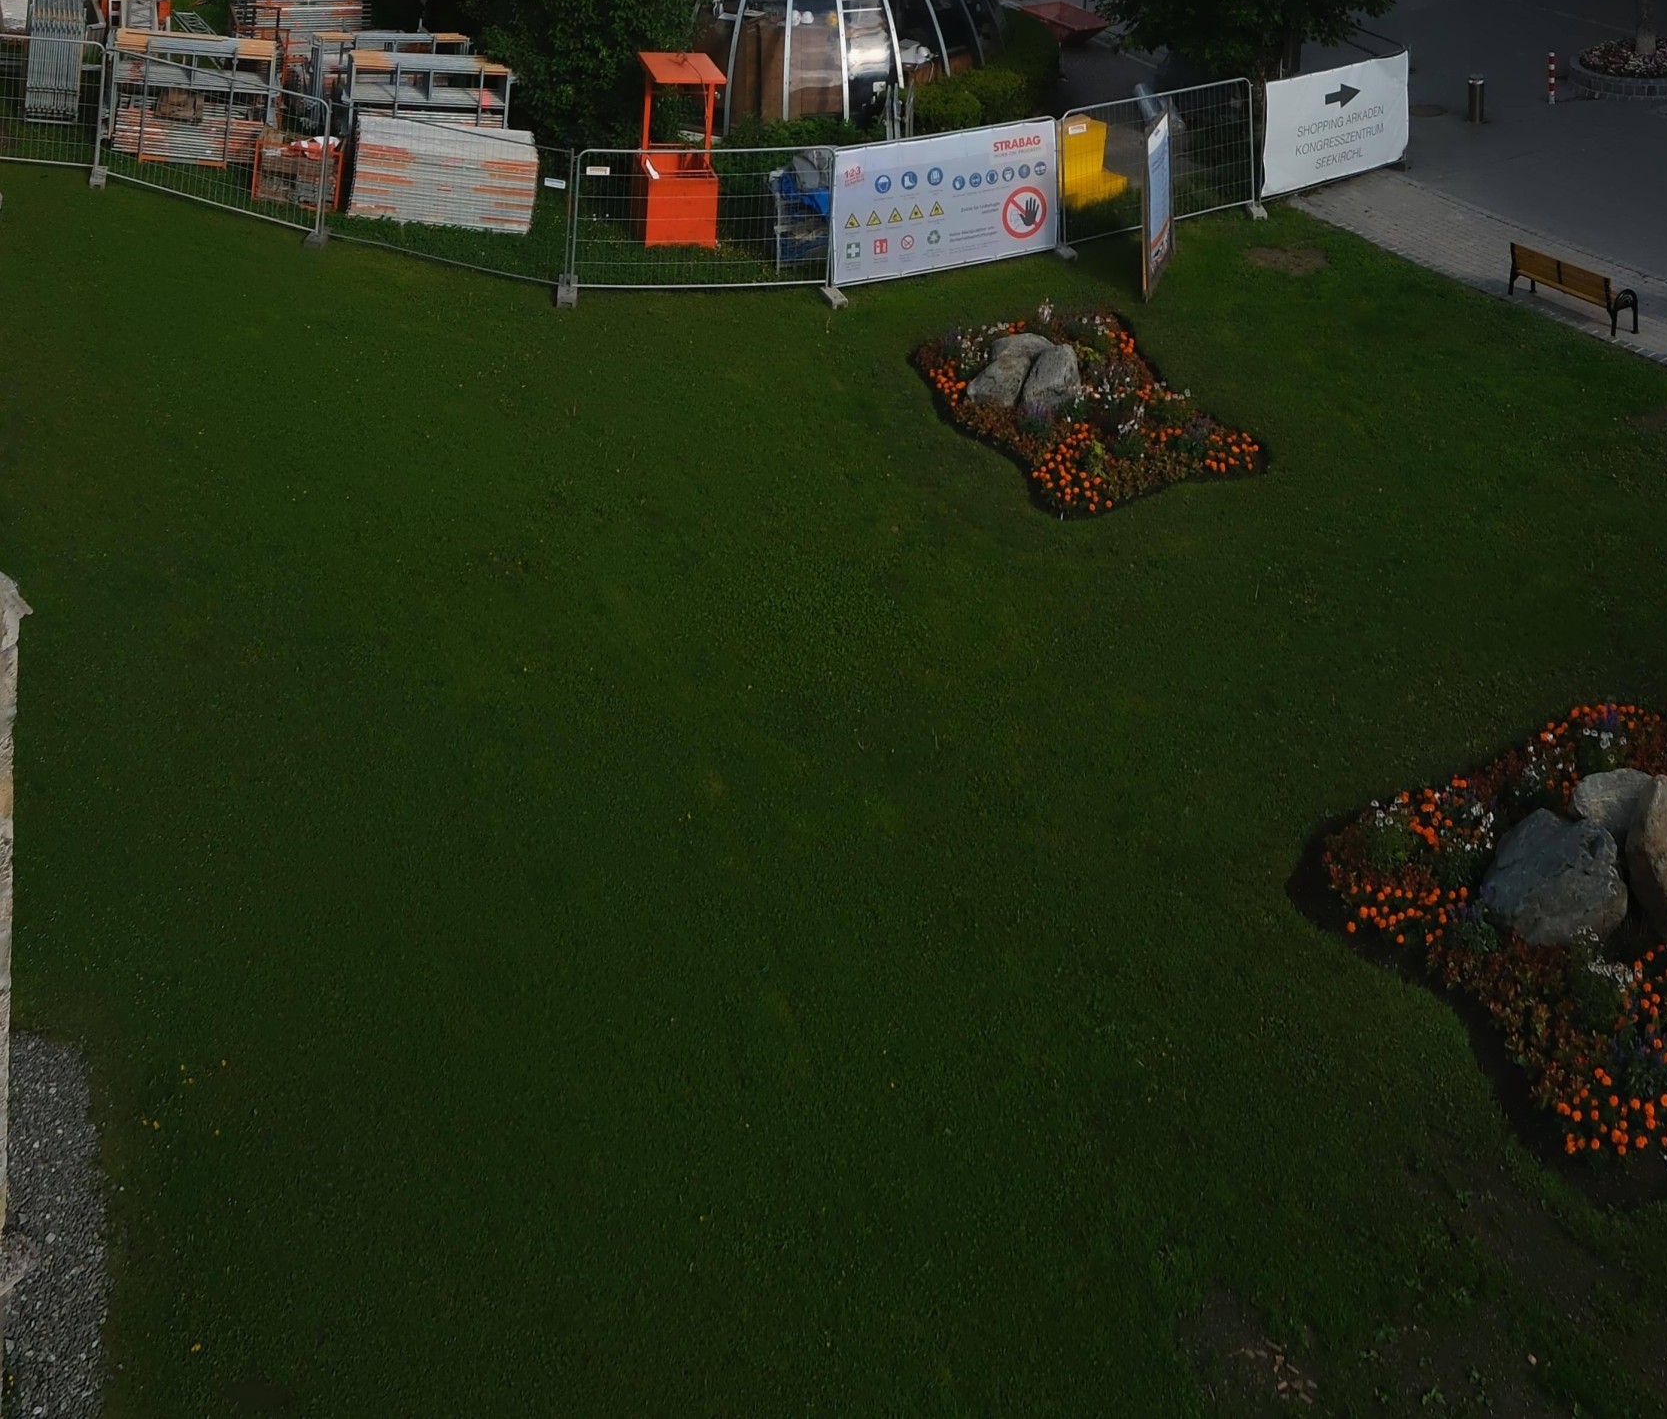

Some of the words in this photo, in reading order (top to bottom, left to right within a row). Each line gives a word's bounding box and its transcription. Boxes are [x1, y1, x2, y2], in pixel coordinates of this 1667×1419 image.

[1297, 117, 1343, 138] SHOPPING
[1346, 105, 1385, 125] ARKADEN
[993, 135, 1041, 152] STRABAG
[1295, 123, 1385, 156] KONGRESSZENTRUM
[1315, 148, 1364, 169] SEEKIRCHL
